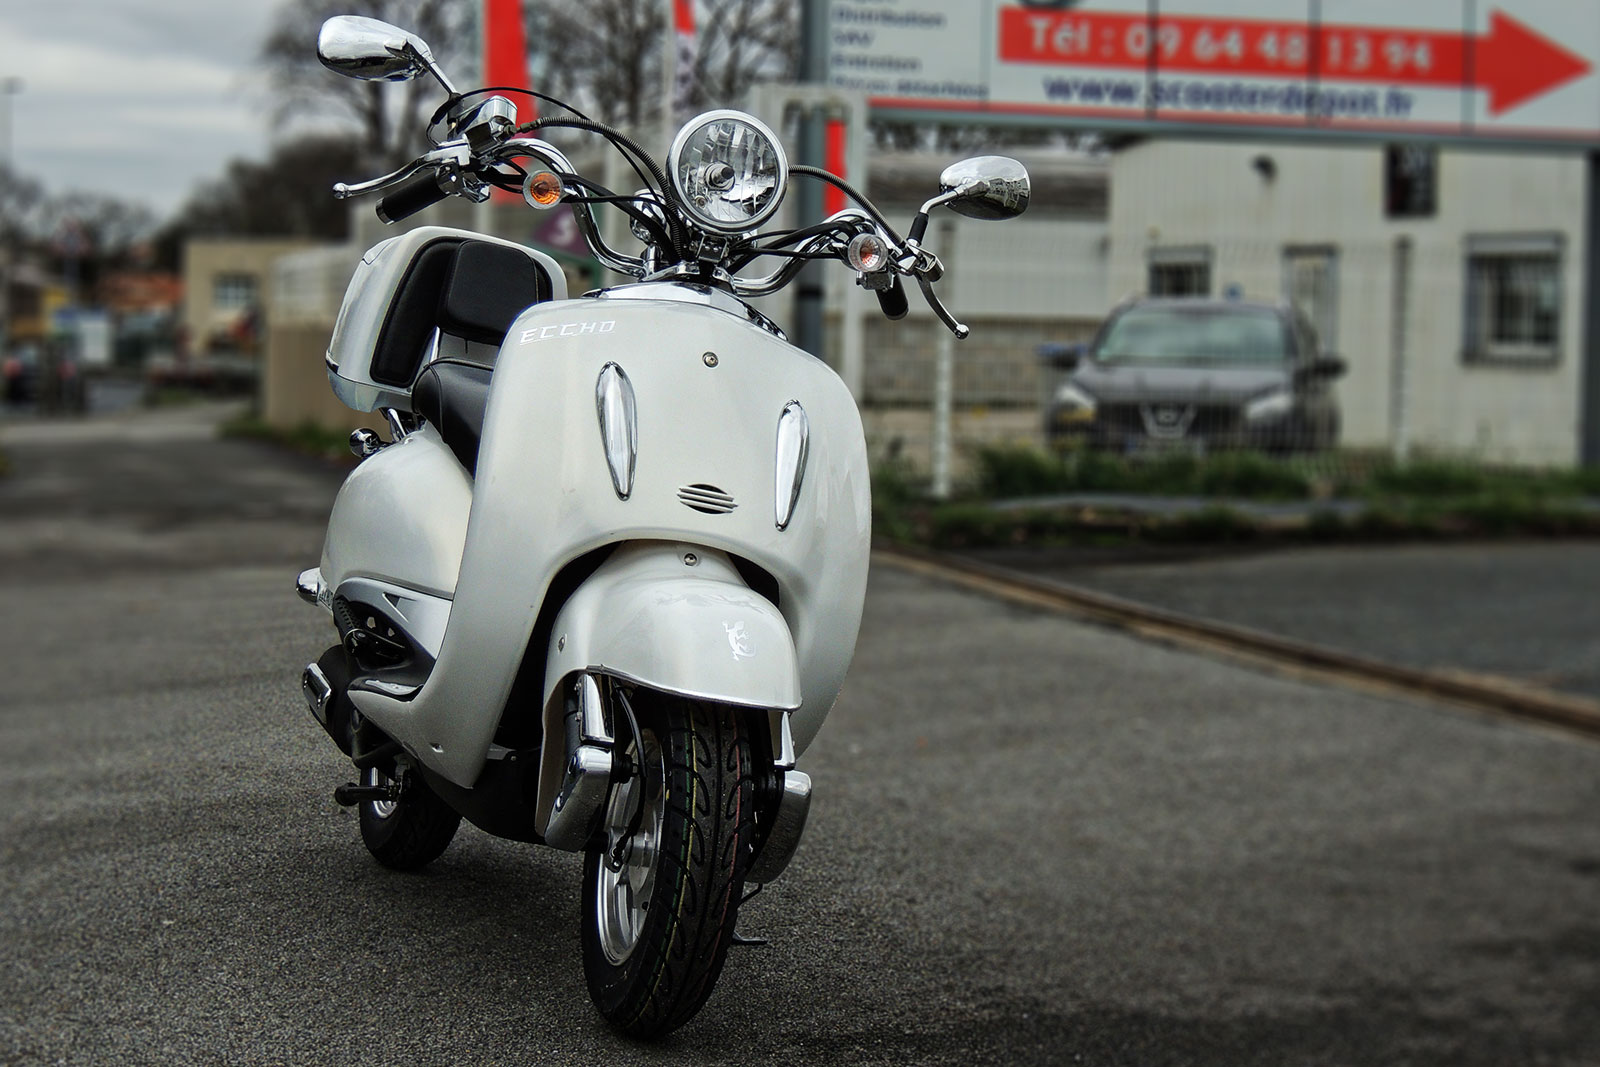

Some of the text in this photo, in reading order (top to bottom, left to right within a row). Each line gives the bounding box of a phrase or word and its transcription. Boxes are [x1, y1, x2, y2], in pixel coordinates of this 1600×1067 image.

[1027, 17, 1090, 54] Tél
[1126, 24, 1181, 60] 09
[1193, 29, 1241, 62] 64
[1328, 38, 1372, 70] 13
[1383, 41, 1432, 74] 94
[520, 320, 616, 344] ECCHO
